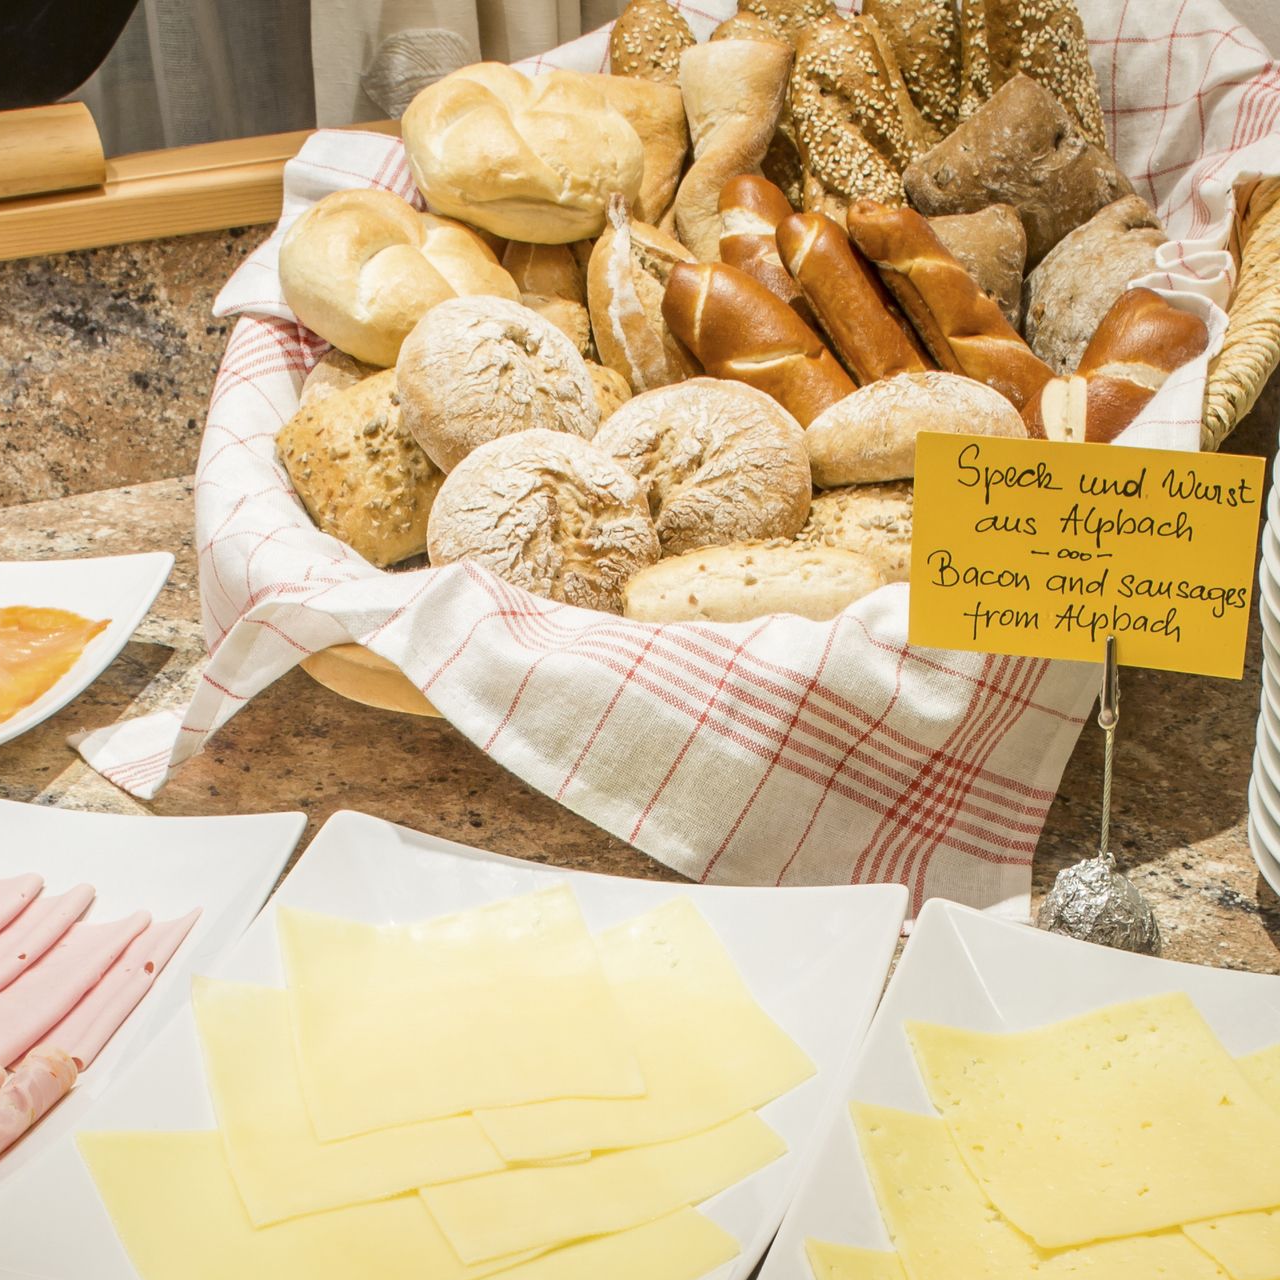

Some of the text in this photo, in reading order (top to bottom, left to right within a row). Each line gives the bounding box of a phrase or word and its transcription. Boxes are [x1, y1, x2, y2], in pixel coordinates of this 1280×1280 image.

[957, 443, 1256, 507] Speck und Wurst
[974, 503, 1194, 549] aus Alpbach
[926, 549, 1248, 619] Bacon and sausages
[962, 601, 1182, 643] from Alpbach
